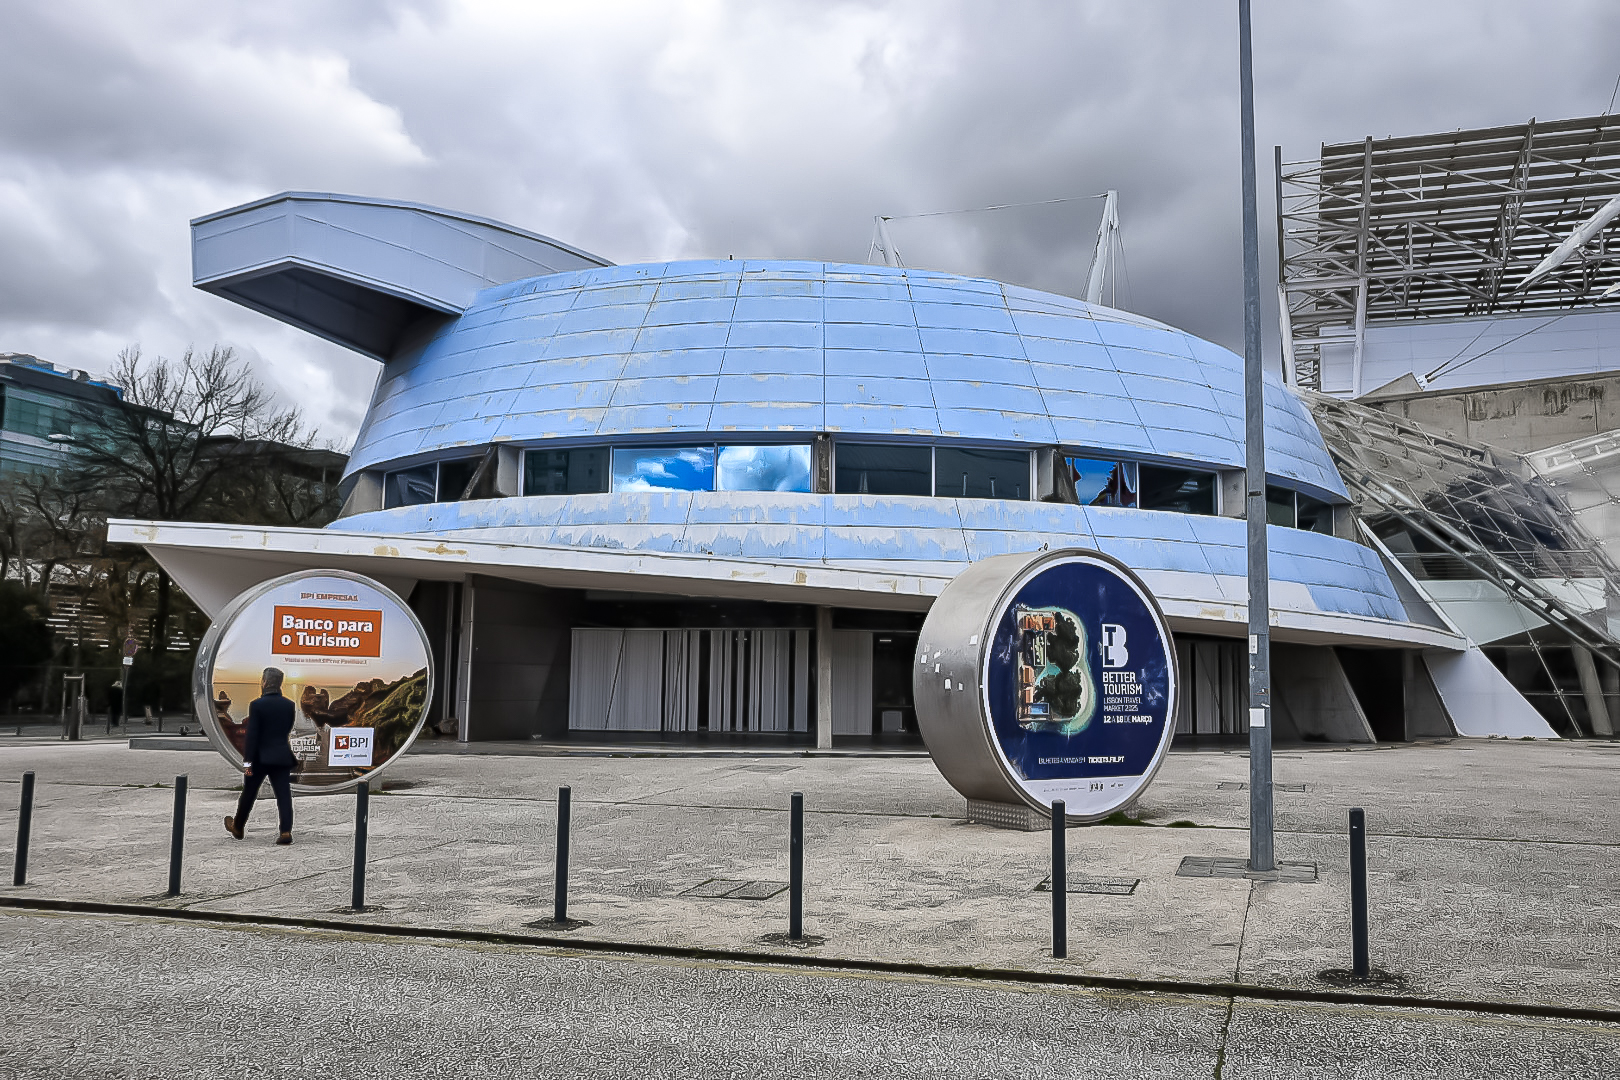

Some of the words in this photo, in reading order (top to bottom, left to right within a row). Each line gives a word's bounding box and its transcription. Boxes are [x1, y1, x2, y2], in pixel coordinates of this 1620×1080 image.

[282, 615, 334, 631] Banco
[338, 620, 373, 634] para
[280, 634, 292, 646] o
[296, 631, 360, 648] Turismo
[1102, 671, 1136, 683] BETTER
[1103, 683, 1143, 695] TOURISM
[1103, 704, 1124, 712] MARKET
[1103, 715, 1111, 724] 12
[1131, 715, 1152, 725] MARÇO
[350, 737, 368, 748] BPI
